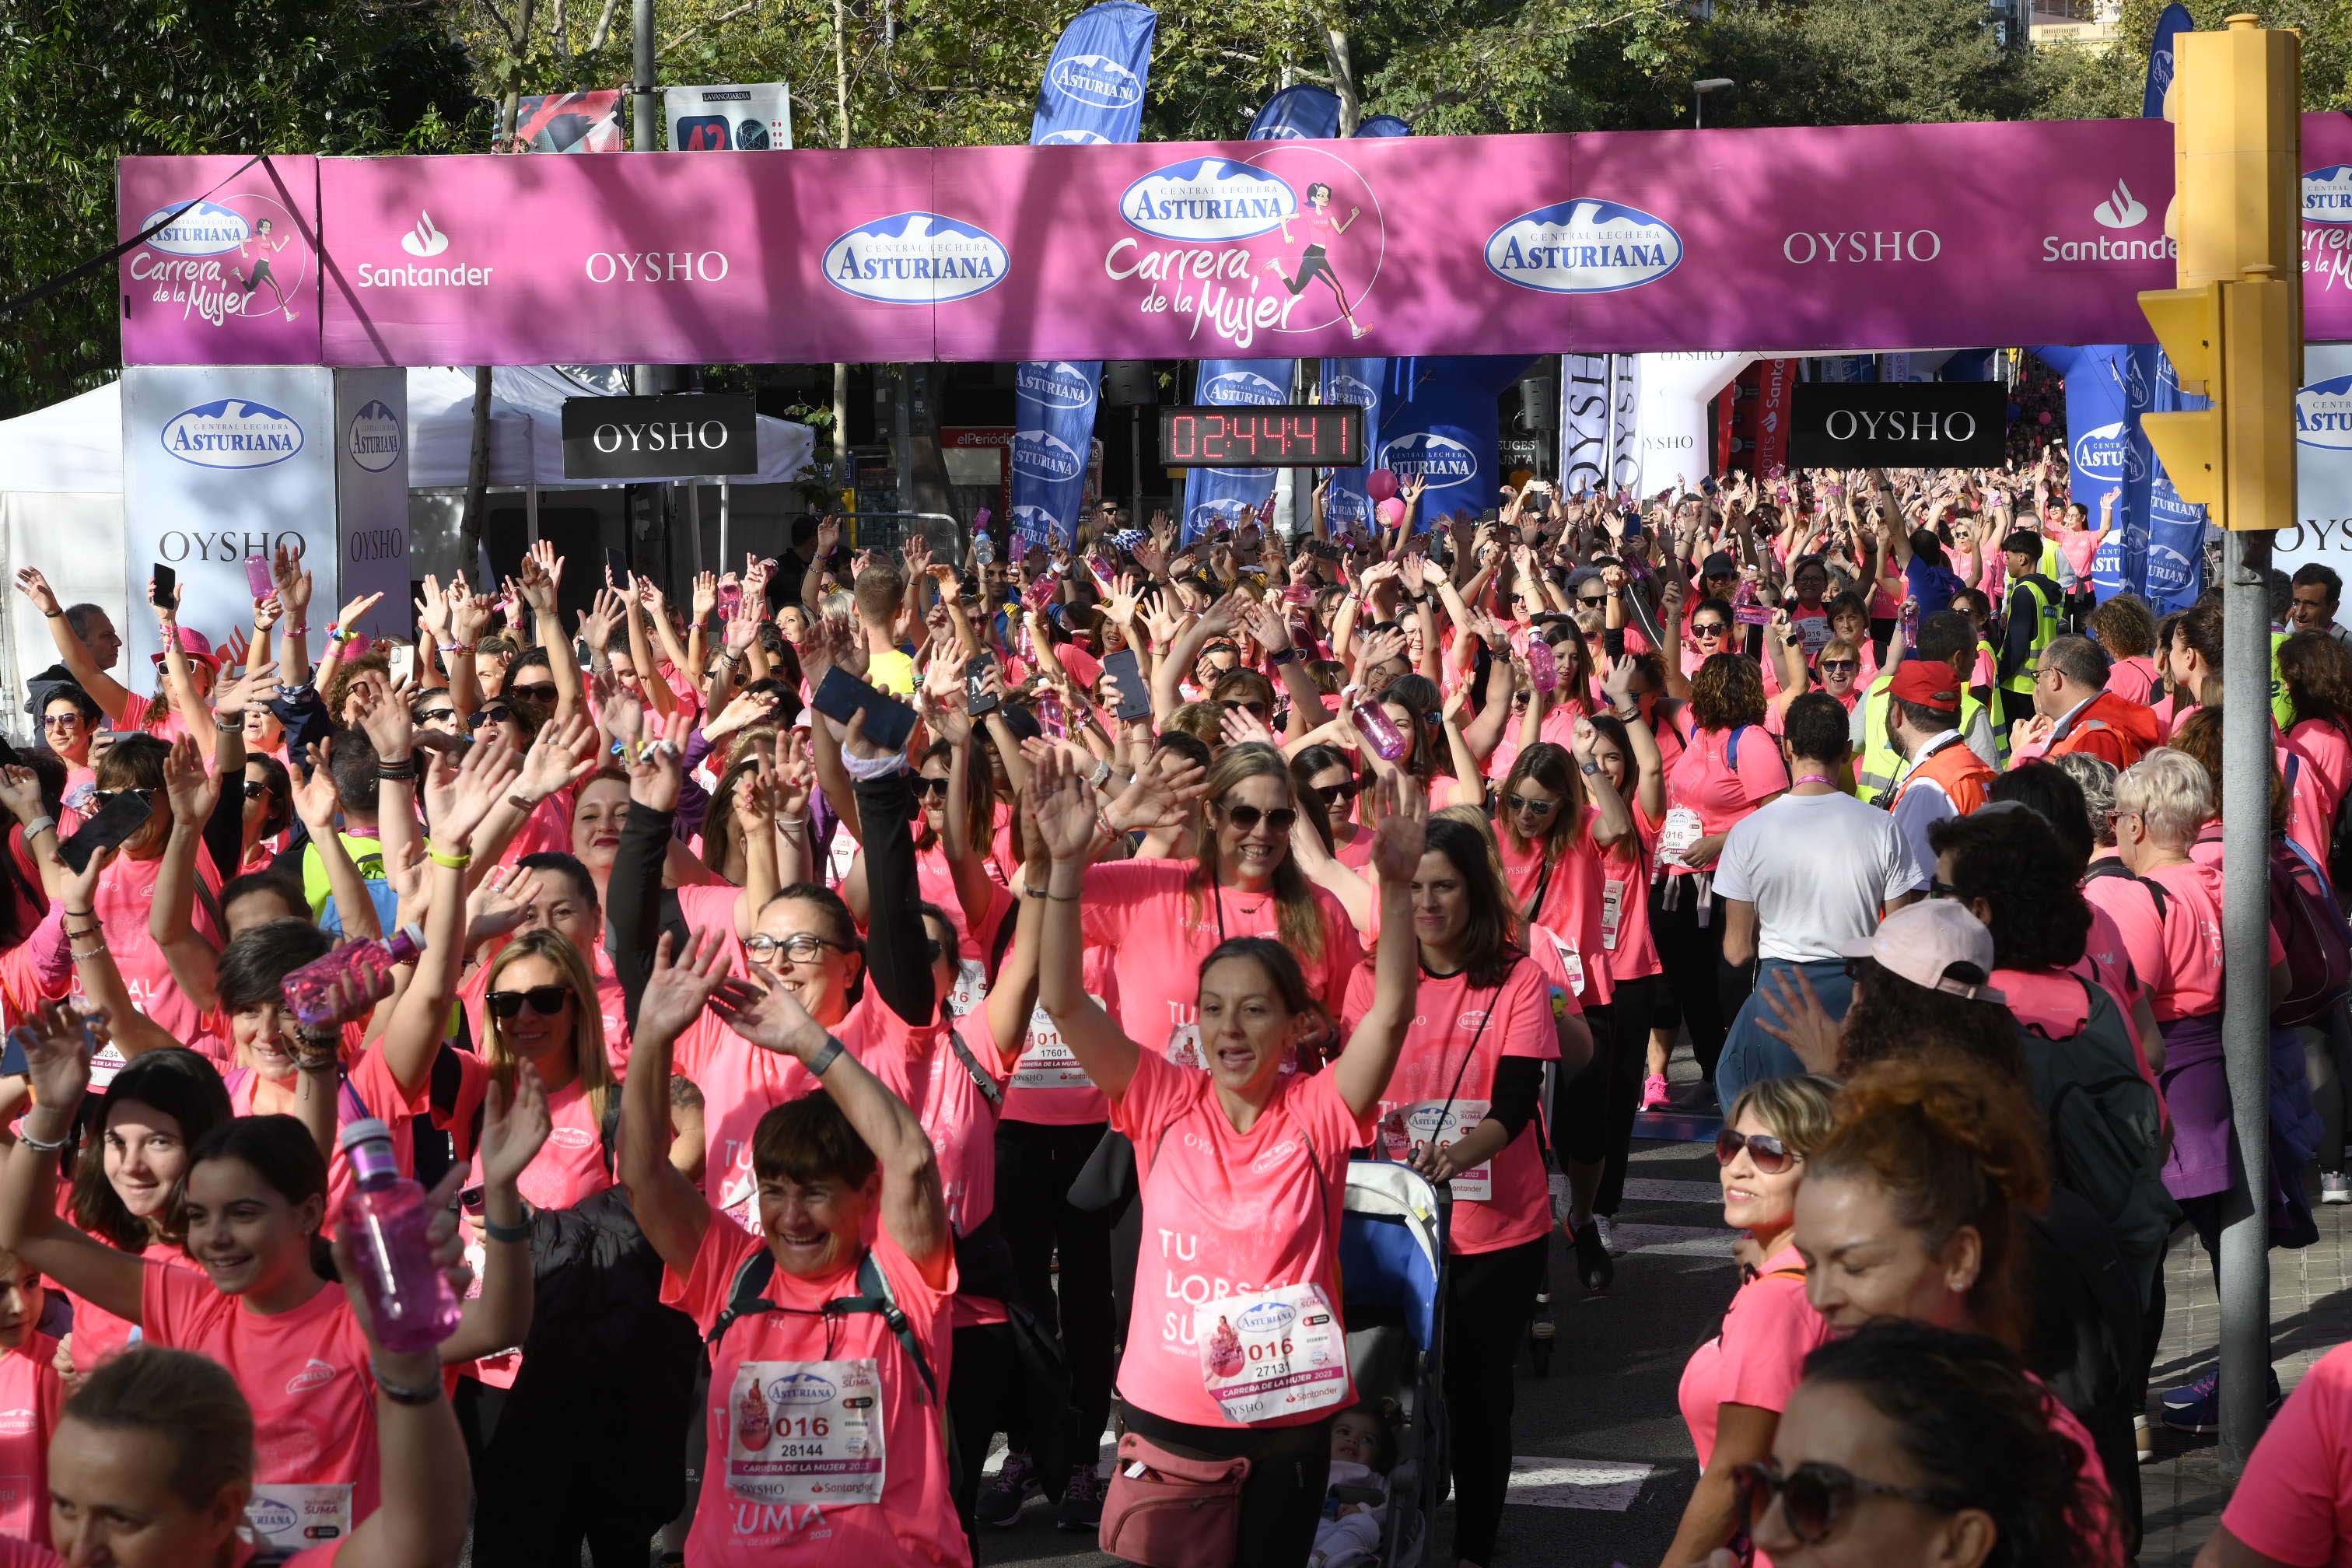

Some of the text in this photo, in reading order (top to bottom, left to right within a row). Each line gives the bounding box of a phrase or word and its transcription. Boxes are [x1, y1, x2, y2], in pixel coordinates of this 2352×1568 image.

[1057, 65, 1133, 101] ASTURIANA
[1161, 185, 1278, 195] CENTRAL LECHERA
[1134, 189, 1281, 221] ASTURIANA
[866, 243, 989, 254] CENTRAL LECHERA
[1531, 230, 1661, 242] CENTRAL LECHERA
[1783, 229, 1941, 264] OYSHO
[2042, 233, 2178, 262] Santande
[836, 247, 996, 280] ASTURIANA
[1105, 237, 1251, 281] Carrera
[1500, 235, 1668, 270] ASTURIANA
[130, 252, 221, 281] Carrera
[358, 262, 493, 287] Santander
[586, 250, 729, 283] OYSHO
[153, 278, 256, 327] de la Mujer
[1141, 275, 1306, 348] de la Mujer
[1016, 367, 1086, 402] ASTURIANA
[173, 424, 294, 451] ASTURIANA
[593, 419, 729, 453] OYSHO
[1825, 409, 1976, 442] OYSHO
[353, 427, 398, 454] ASTURIANA
[1643, 435, 1693, 450] YSHO
[1013, 450, 1073, 476] STURIANA
[1384, 455, 1470, 475] ASTURIANA
[2081, 444, 2123, 467] ASTU
[2151, 495, 2202, 519] TURIANA
[159, 530, 306, 562] OYSHO
[351, 527, 402, 562] OYSHO
[2148, 564, 2187, 586] URIANA
[1666, 831, 1683, 839] 016
[953, 990, 969, 1003] 16
[1038, 1032, 1058, 1045] 01
[1412, 1115, 1453, 1126] ASTURNA
[1158, 1228, 1197, 1262] TU
[1162, 1311, 1196, 1346] SU
[1242, 1310, 1293, 1328] ASTURIANA
[1248, 1337, 1294, 1360] 016
[1255, 1362, 1290, 1378] 27131
[772, 1385, 831, 1398] ASTURIANA
[842, 1379, 872, 1388] SUMA
[1222, 1370, 1333, 1398] CARRERA DE LA MUJER 2023
[1297, 1386, 1337, 1401] Santander
[775, 1417, 830, 1437] 016
[781, 1444, 824, 1458] 28144
[740, 1482, 873, 1495] OYSHO Santander
[304, 1505, 338, 1515] SUMA
[728, 1503, 828, 1535] UMA
